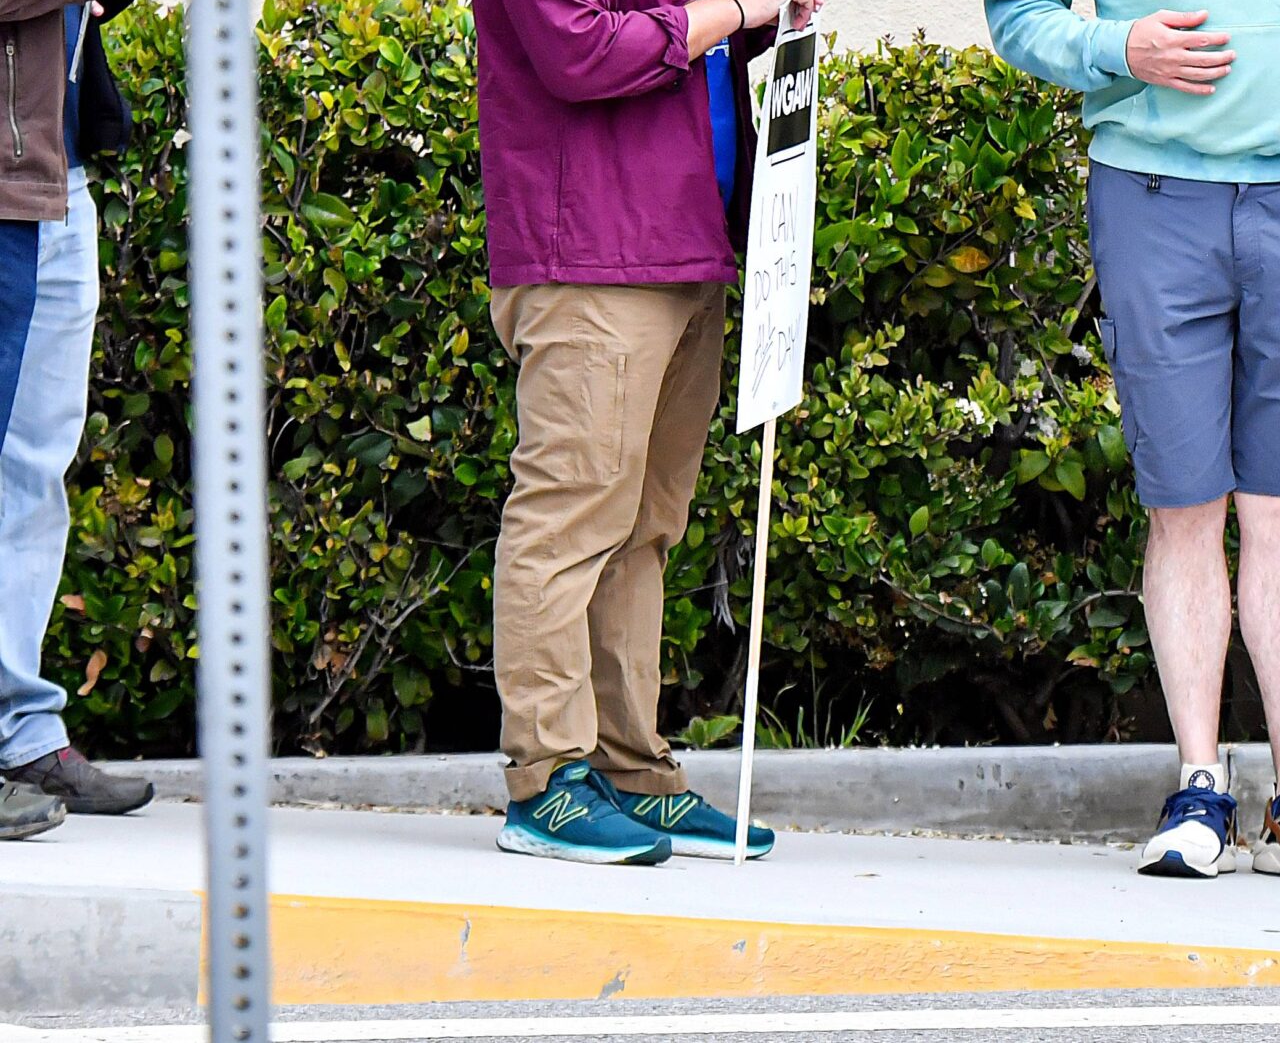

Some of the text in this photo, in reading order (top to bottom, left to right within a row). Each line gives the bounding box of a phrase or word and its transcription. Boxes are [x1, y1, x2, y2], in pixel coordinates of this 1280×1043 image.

[771, 67, 815, 120] WGAW
[771, 185, 799, 243] CAN
[754, 270, 771, 311] DO
